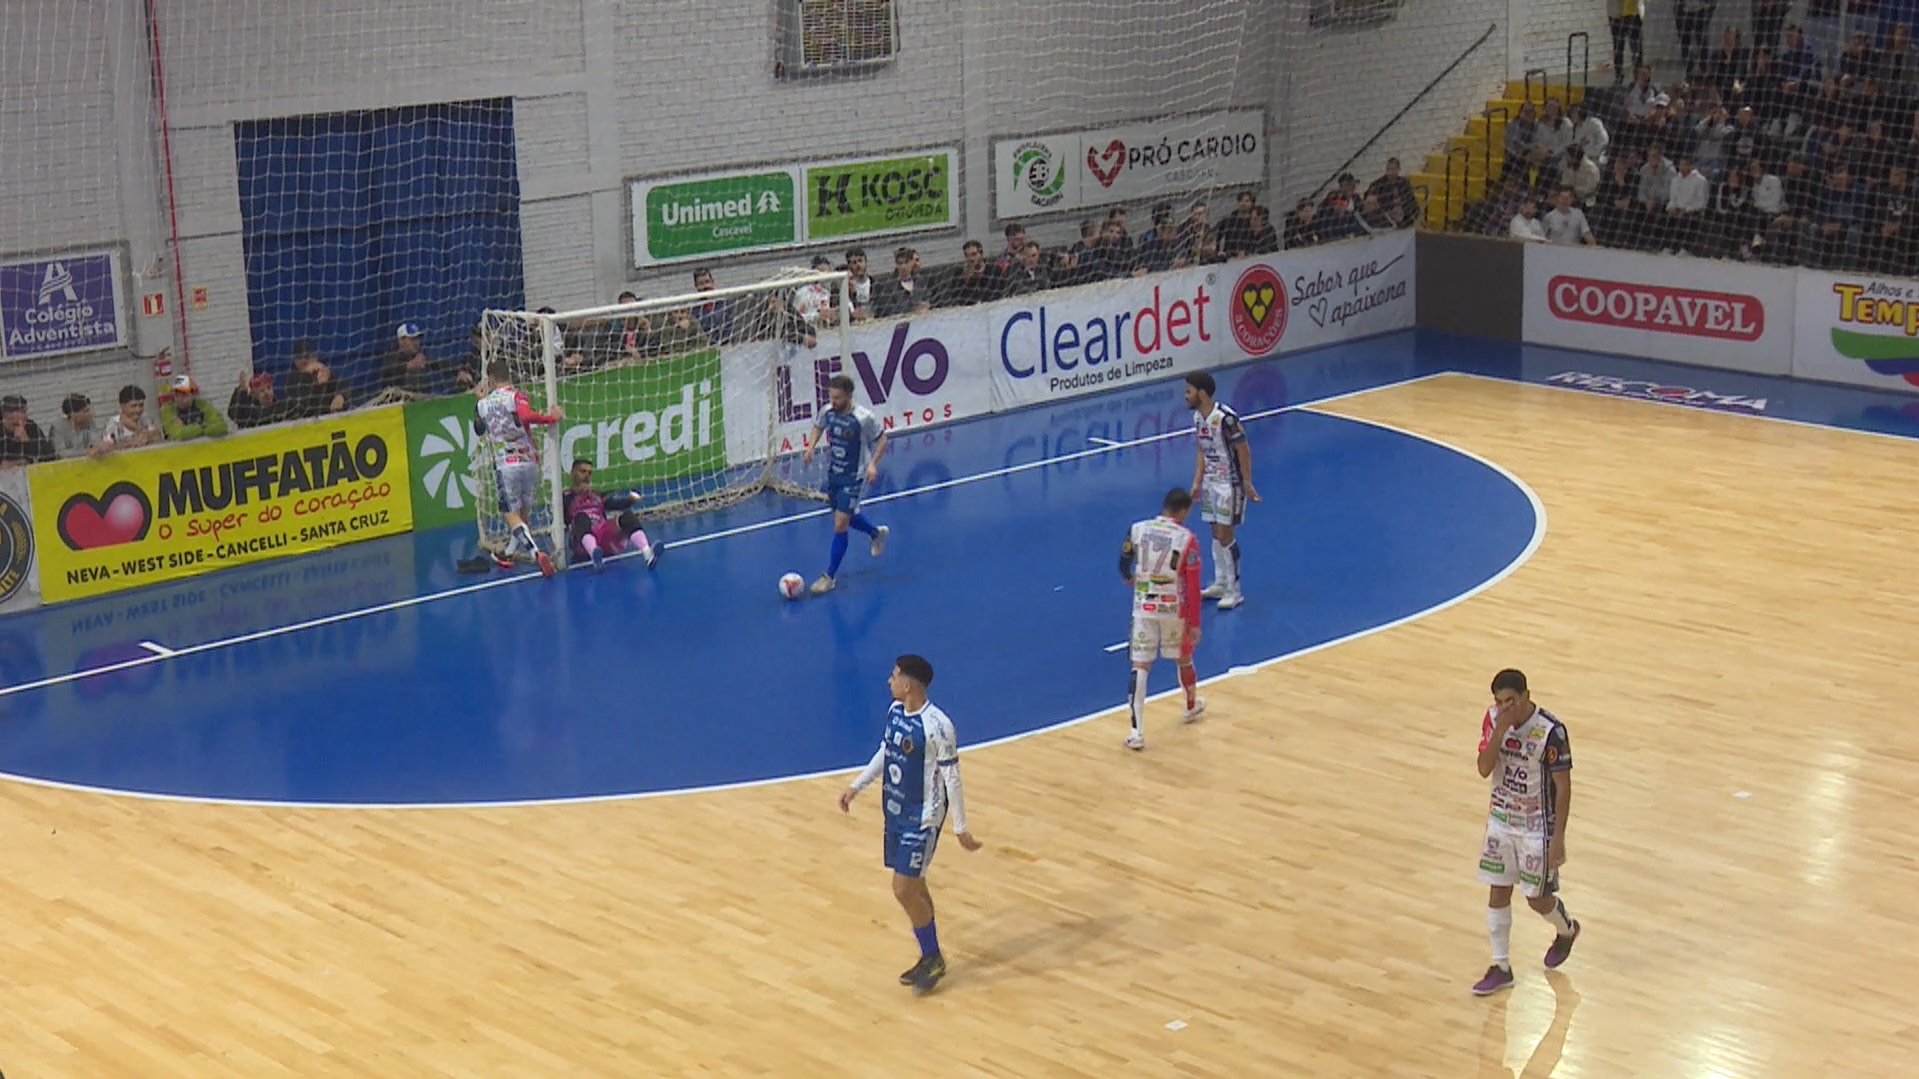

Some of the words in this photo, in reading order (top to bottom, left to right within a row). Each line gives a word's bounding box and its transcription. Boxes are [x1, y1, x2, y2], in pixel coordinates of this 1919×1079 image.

[1128, 136, 1172, 170] PRÓ
[1178, 133, 1256, 162] CARDIO
[861, 166, 943, 208] KOSC
[662, 192, 752, 227] Unimed
[1291, 270, 1342, 306] Sabor
[1347, 254, 1404, 296] que
[1864, 281, 1902, 297] Alhos
[25, 302, 93, 324] Colégio
[1330, 280, 1406, 327] apaixona
[1554, 281, 1756, 335] COOPAVEL
[9, 320, 116, 346] Adventista
[1000, 285, 1211, 380] Cleardet
[1050, 371, 1104, 393] Produtos
[1107, 366, 1122, 379] de
[1125, 355, 1174, 378] Limpeza
[781, 404, 953, 452] ALINTOS
[158, 430, 388, 519] MUFFATÃO
[258, 504, 283, 525] do
[122, 555, 165, 580] WEST
[301, 521, 346, 543] SANTA
[350, 510, 389, 531] CRUZ
[1142, 533, 1173, 573] 17
[909, 851, 923, 869] 12
